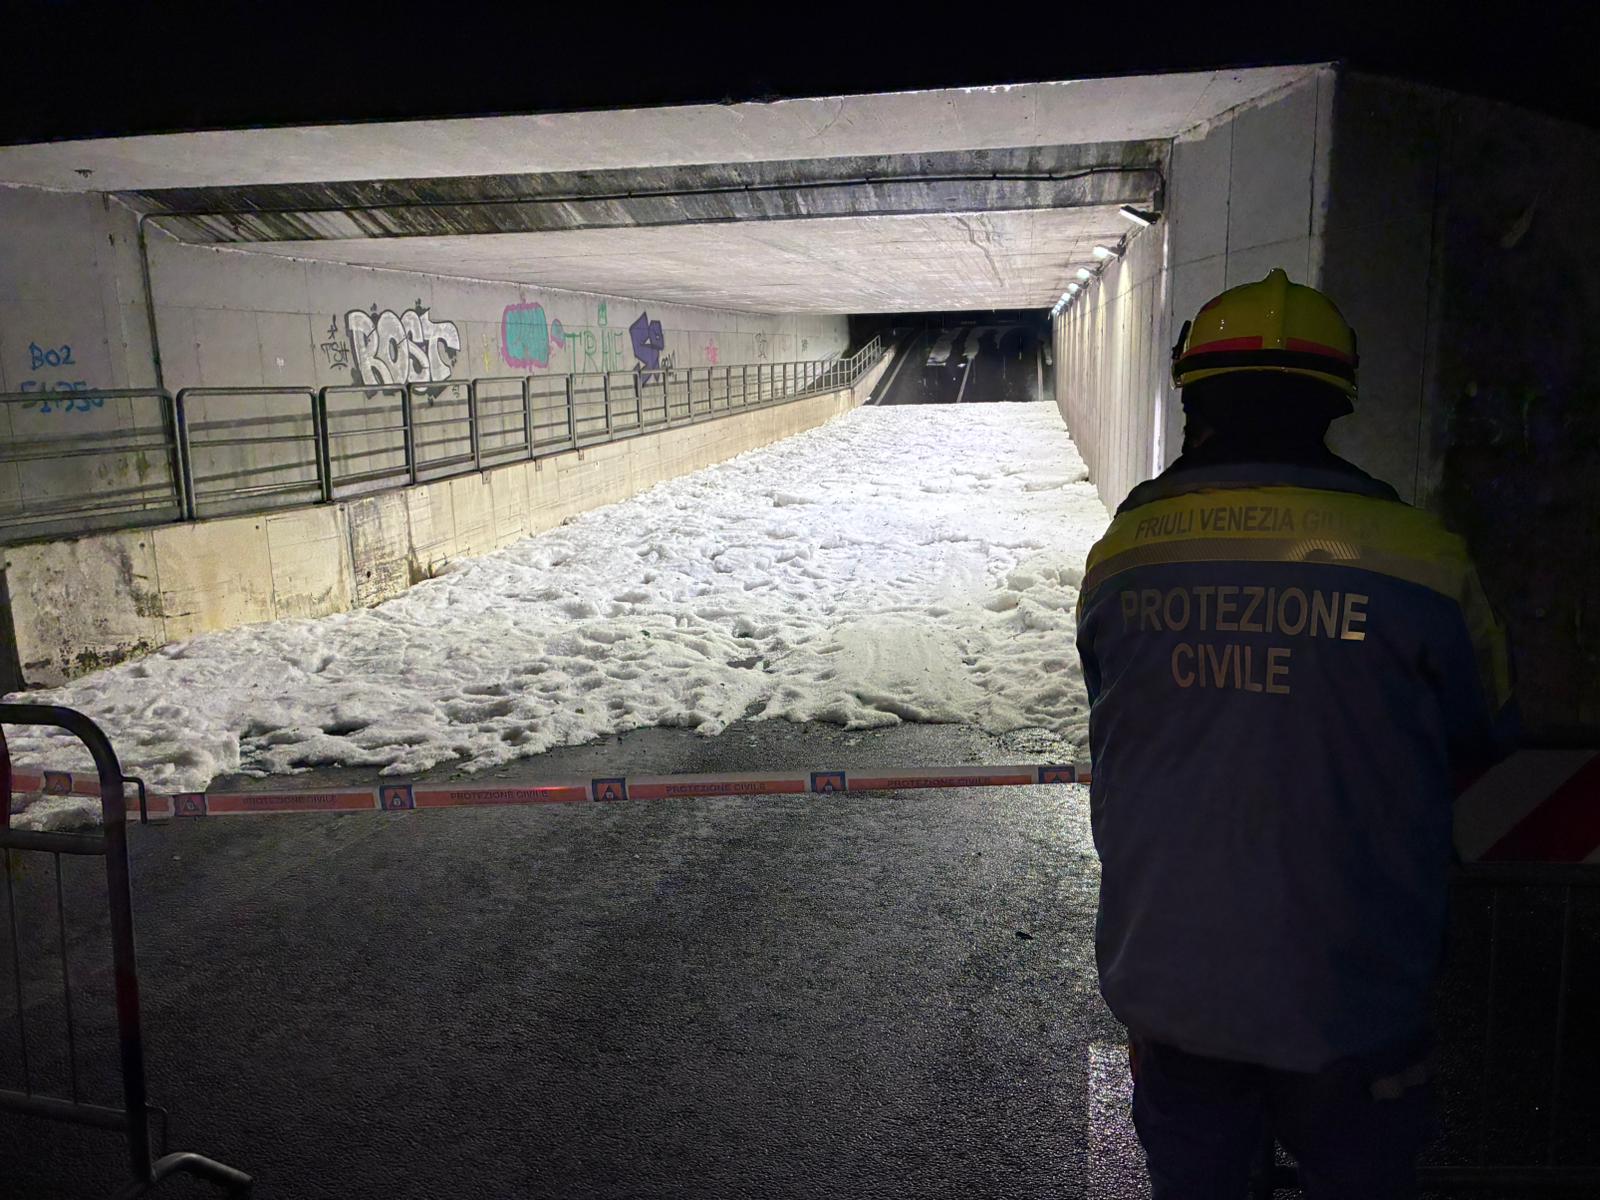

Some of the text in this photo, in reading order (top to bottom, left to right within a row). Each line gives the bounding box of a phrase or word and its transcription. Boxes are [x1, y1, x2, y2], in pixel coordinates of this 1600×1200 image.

[1135, 509, 1193, 541] FRIULI
[1200, 506, 1295, 532] VENEZIA
[1120, 586, 1369, 641] PROTEZIONE
[1171, 643, 1292, 694] CIVILE
[450, 791, 512, 800] PROTEZIONE
